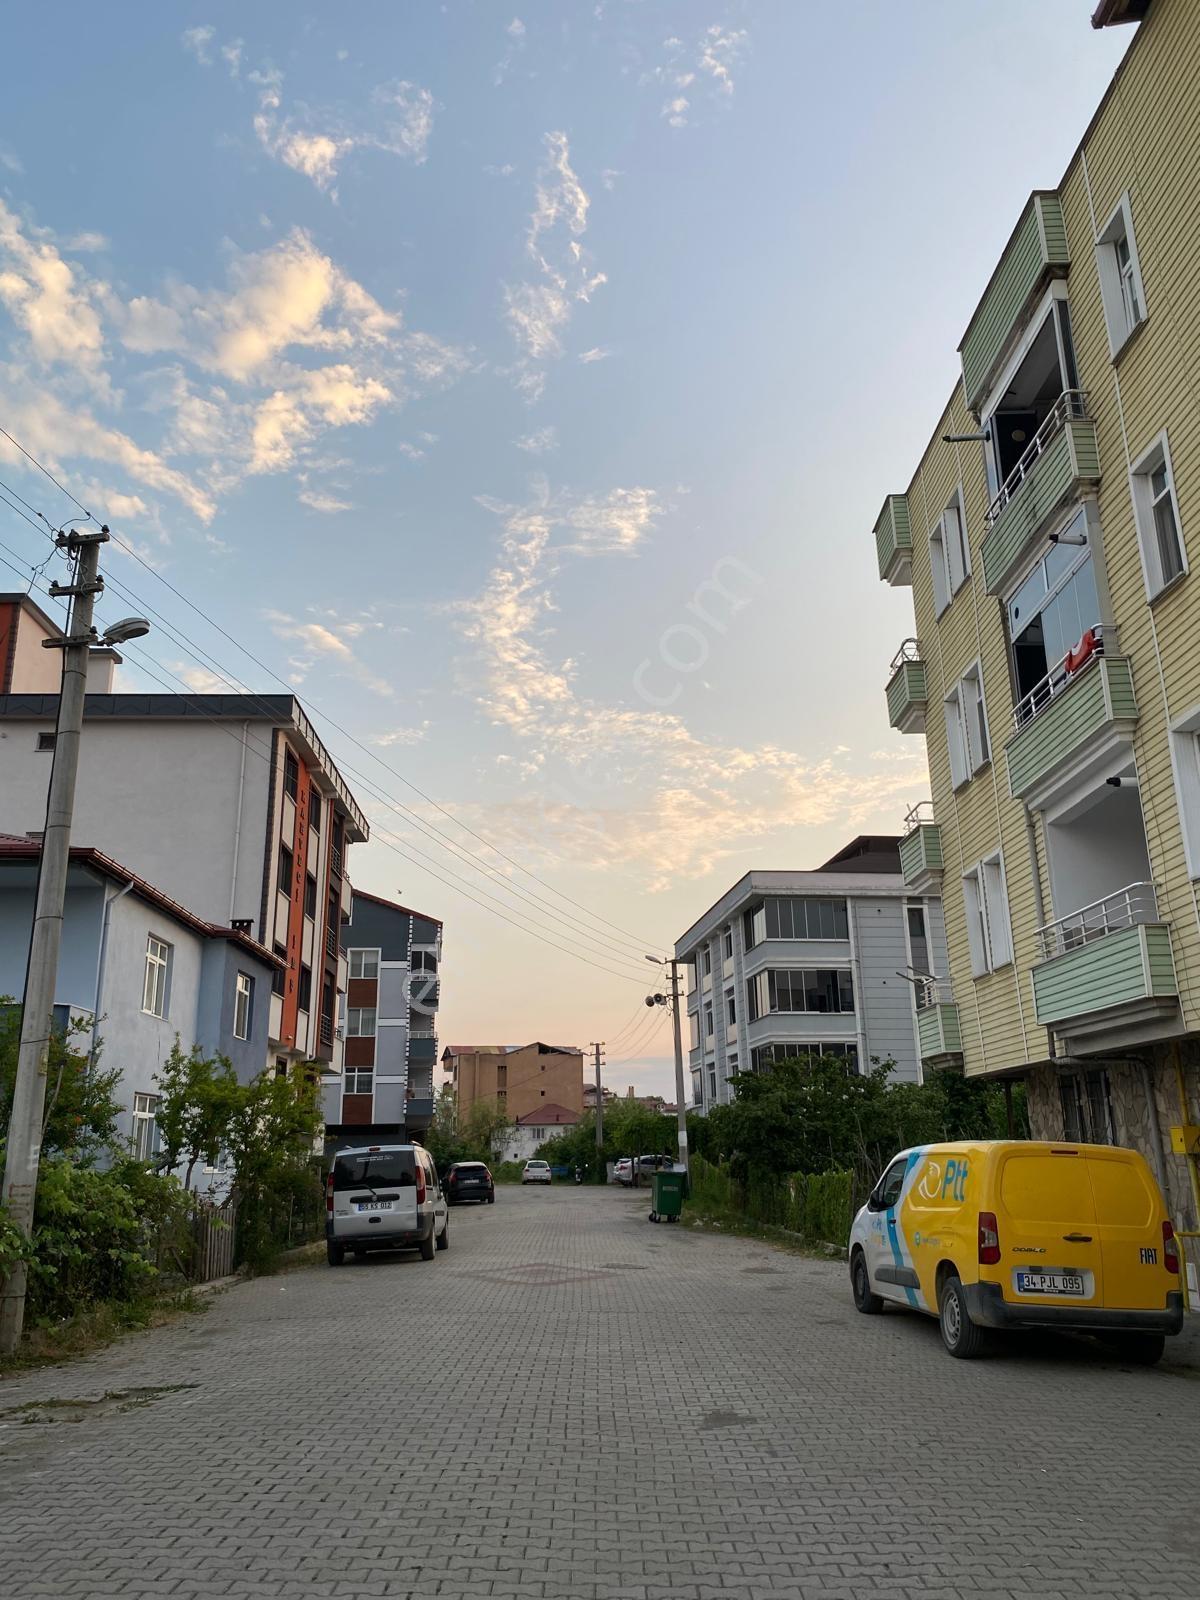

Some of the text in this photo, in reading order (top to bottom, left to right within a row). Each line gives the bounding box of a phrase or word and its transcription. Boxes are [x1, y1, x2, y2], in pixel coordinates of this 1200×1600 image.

[942, 1159, 968, 1202] Ptt
[1139, 1247, 1158, 1265] FIAT
[1024, 1275, 1080, 1290] 34 PJL 095
